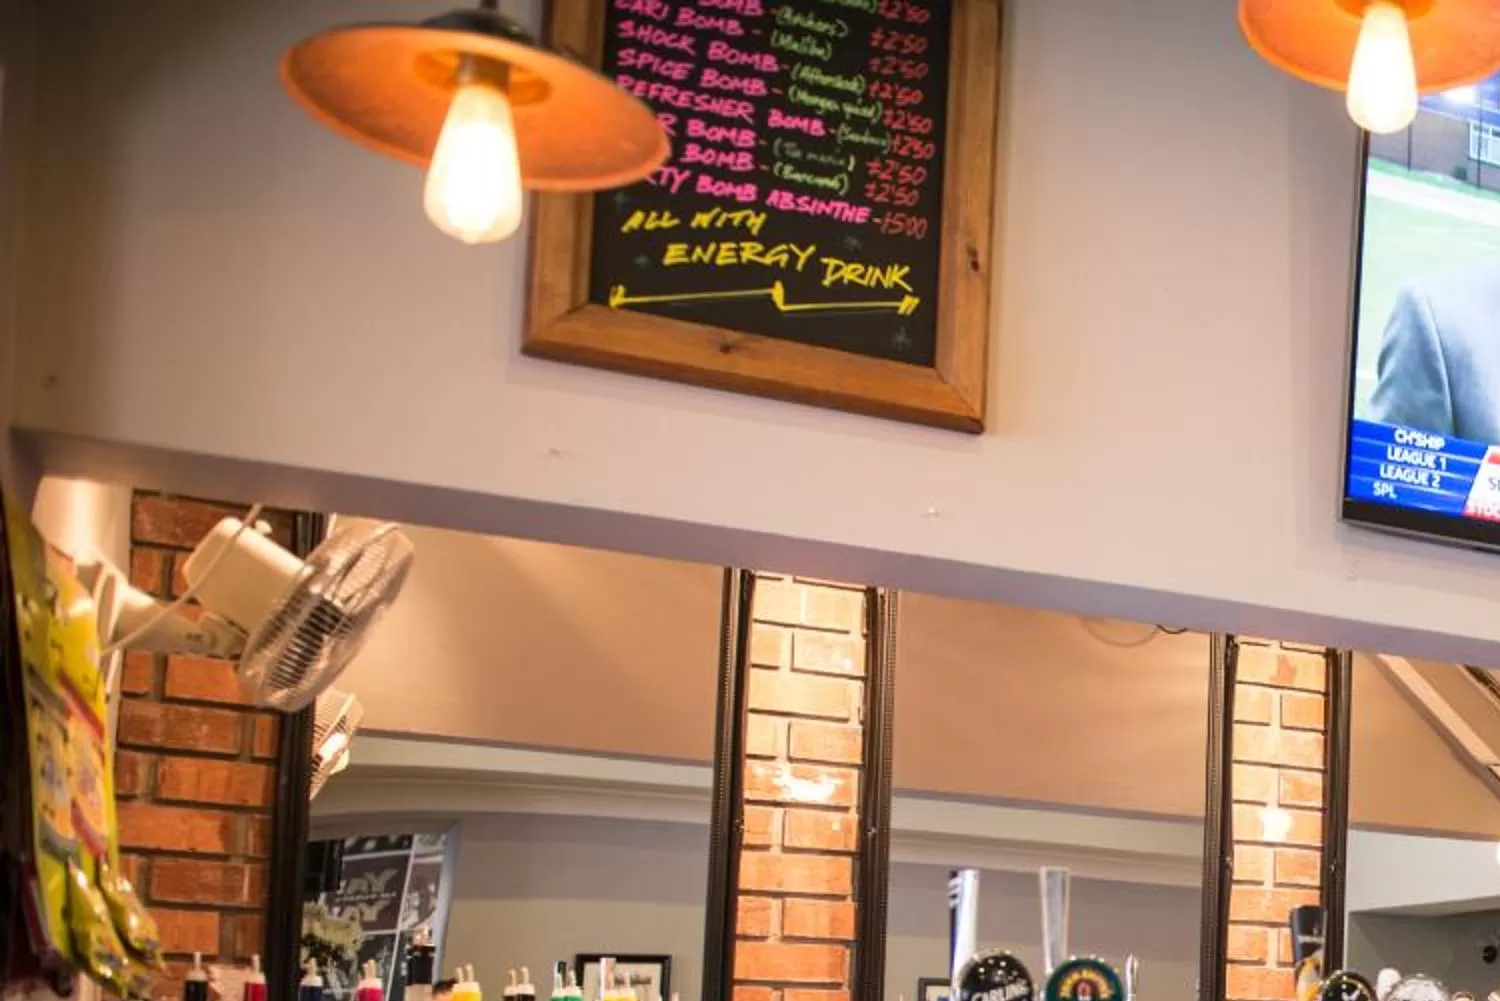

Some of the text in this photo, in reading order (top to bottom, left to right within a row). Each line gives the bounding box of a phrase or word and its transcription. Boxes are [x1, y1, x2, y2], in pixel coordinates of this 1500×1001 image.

[674, 7, 744, 35] BOMB
[616, 19, 696, 56] SHOCK
[707, 40, 779, 72] BOMB
[616, 48, 695, 80] SPICE
[700, 67, 768, 96] BOMB
[615, 73, 756, 124] REFRESHER
[767, 108, 826, 137] BOMB
[687, 118, 756, 149] BOMB
[680, 142, 755, 172] BOMB
[695, 173, 758, 203] BOMB
[765, 189, 872, 224] ABSINTHE
[621, 206, 768, 236] ALL WITH
[662, 241, 913, 292] ENERGY DRINK
[1387, 447, 1437, 469] LEAGUE
[1373, 481, 1397, 499] SPL
[1380, 464, 1441, 488] LEAGUE 2
